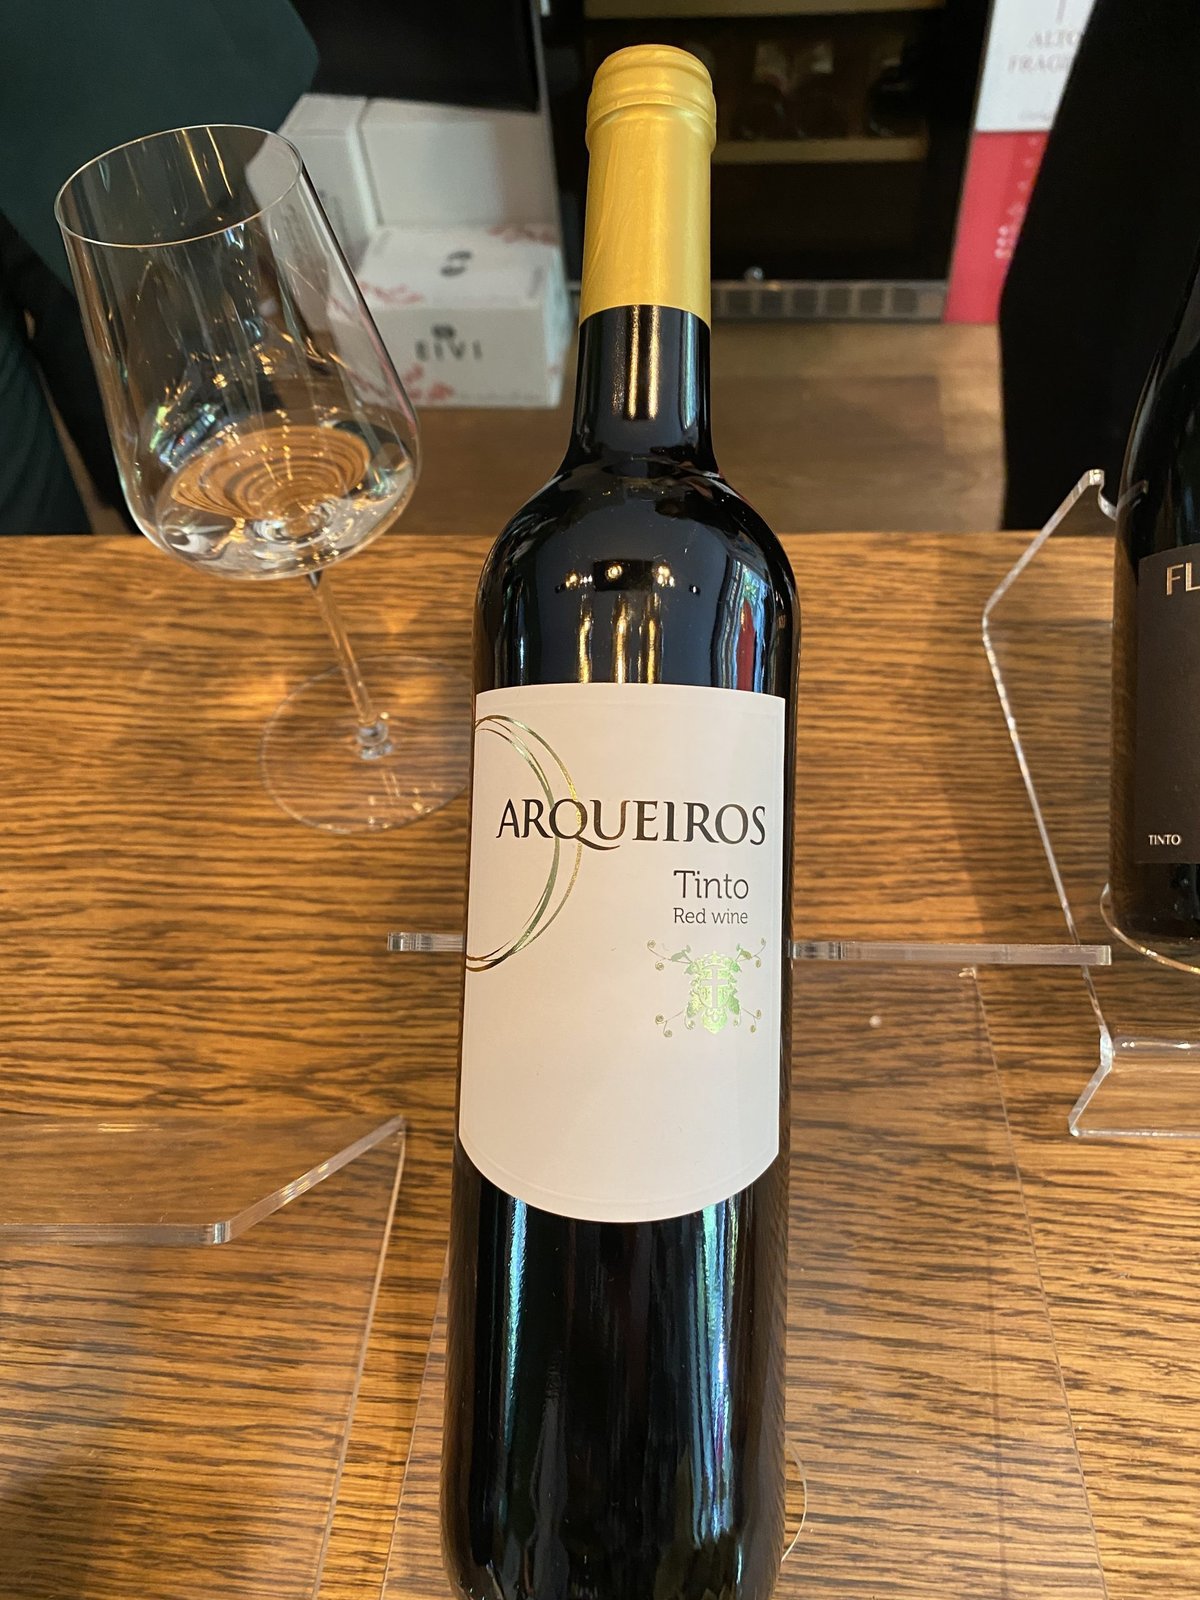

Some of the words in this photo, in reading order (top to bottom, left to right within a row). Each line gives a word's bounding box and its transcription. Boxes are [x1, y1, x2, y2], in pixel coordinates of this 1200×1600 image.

[495, 798, 766, 850] ARQUEIROS
[1148, 834, 1181, 846] TINTO
[673, 869, 749, 899] Tinto
[673, 907, 706, 924] Red
[711, 908, 748, 924] wine
